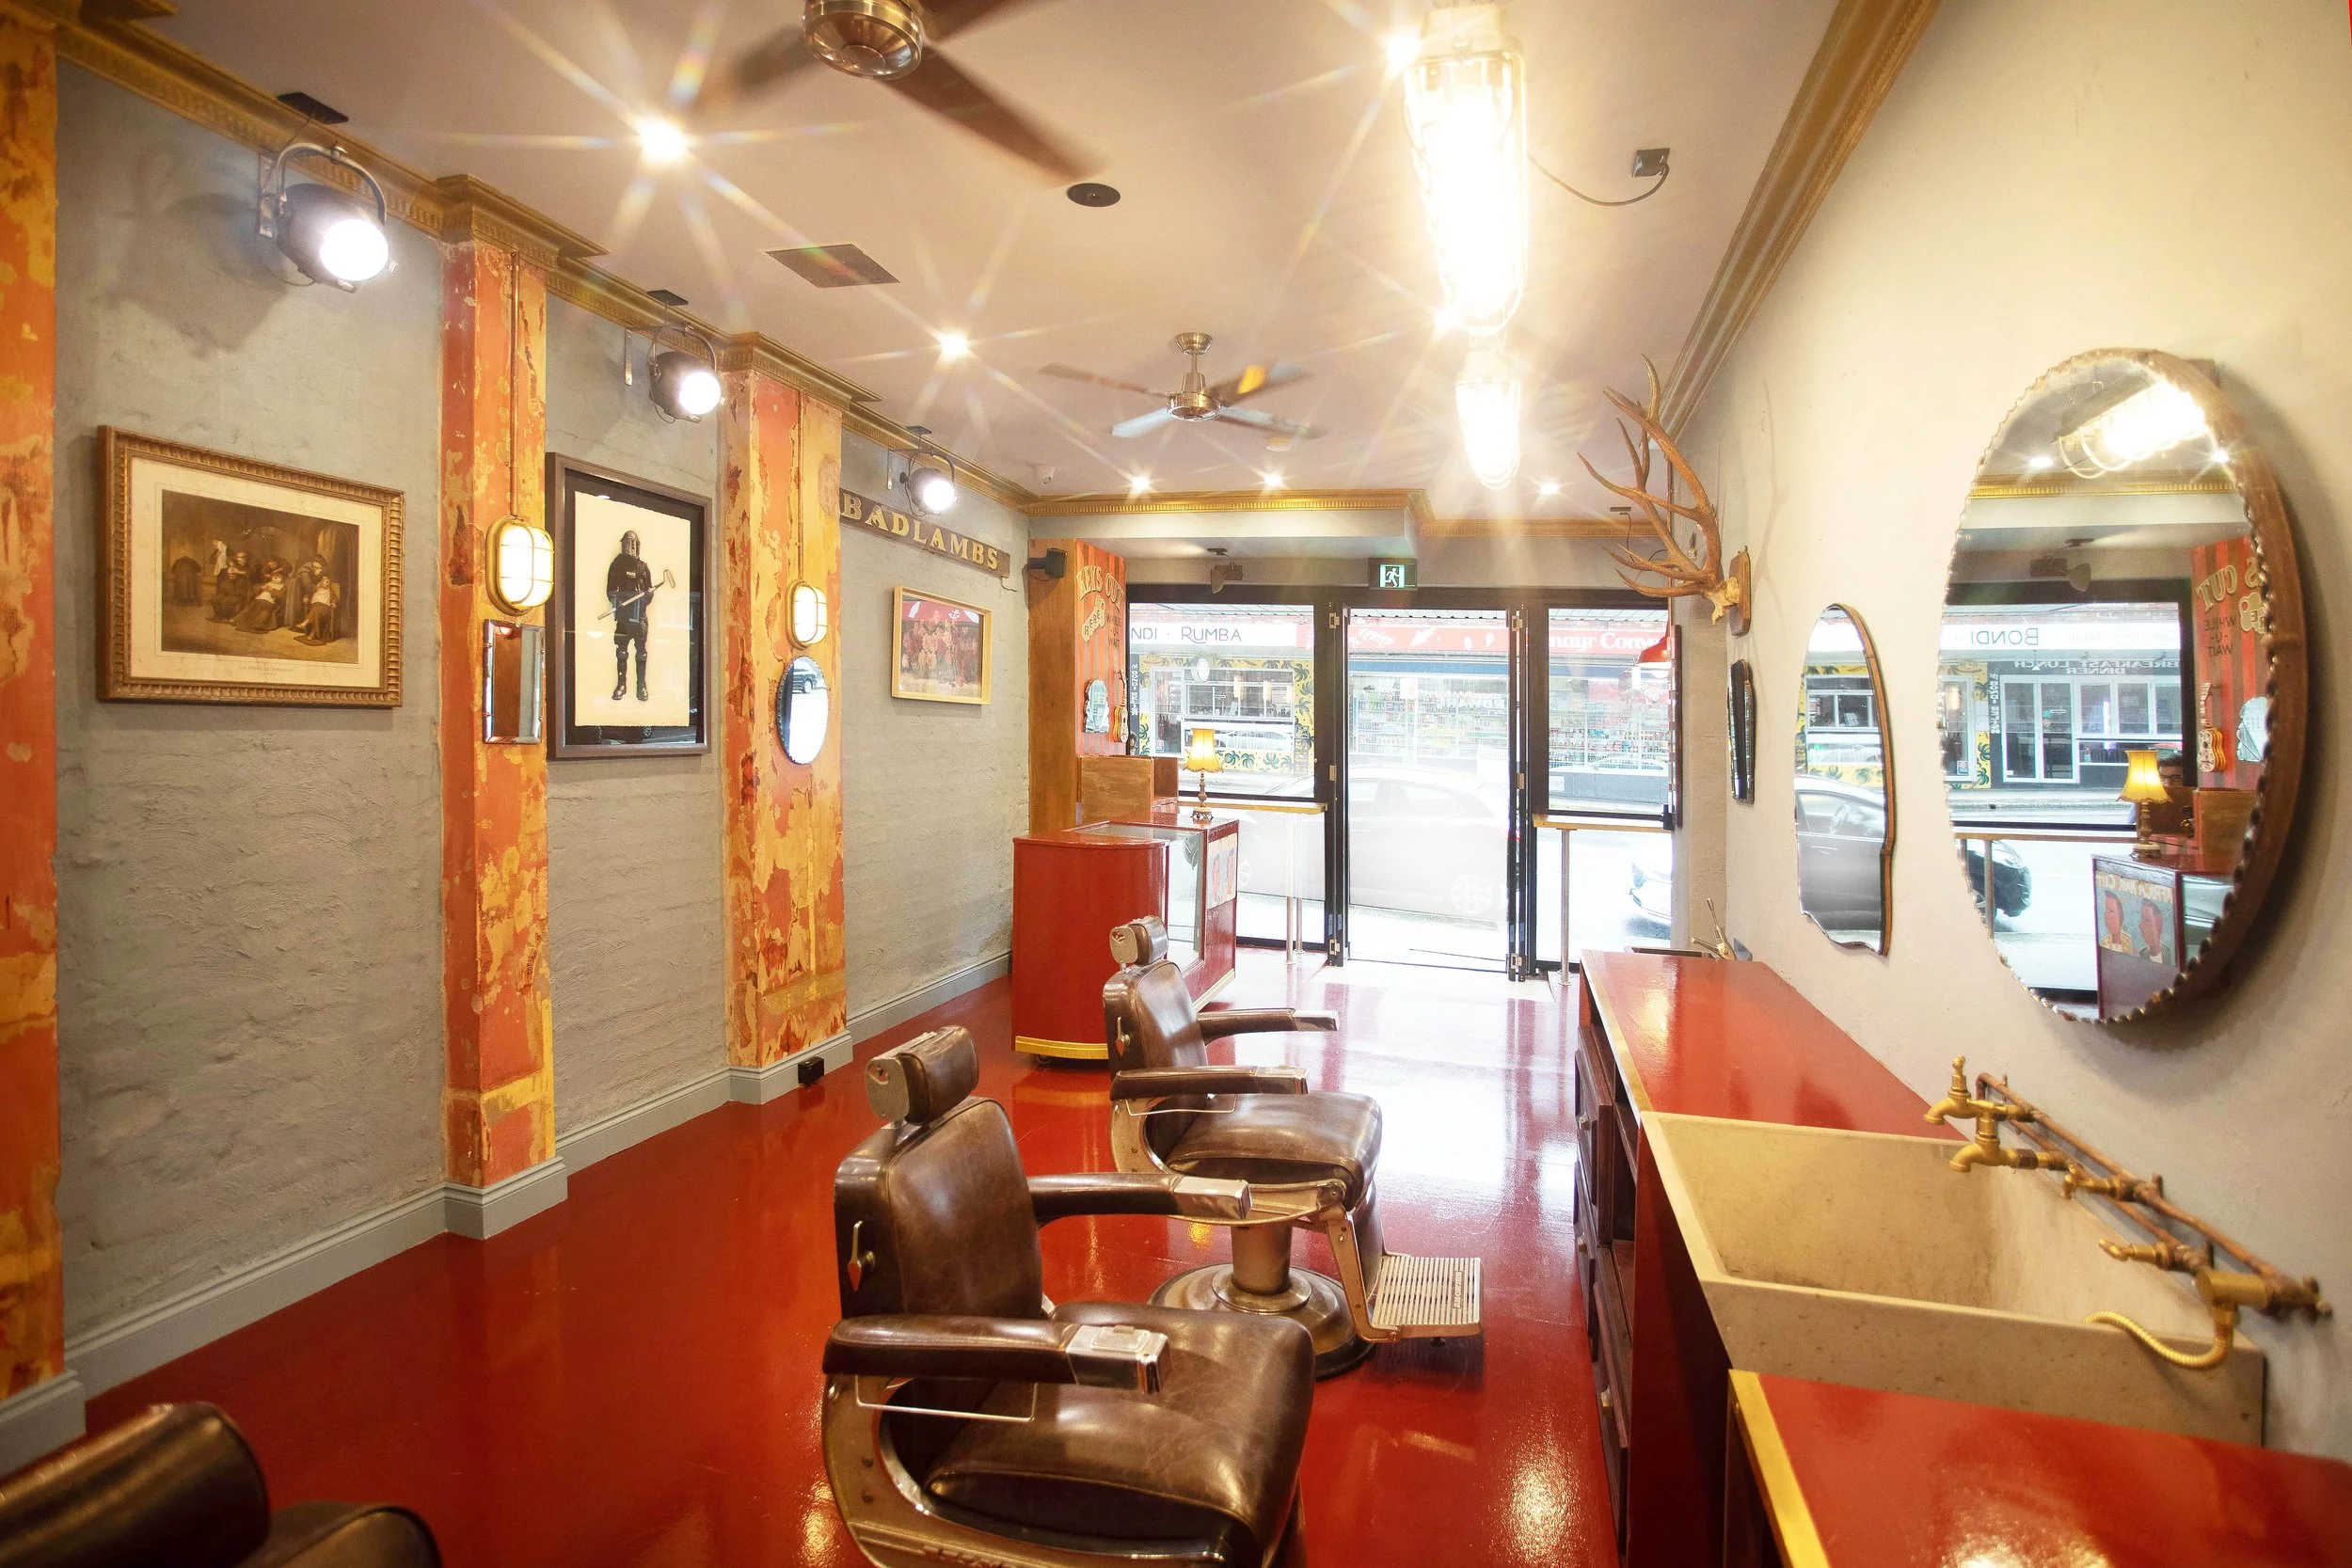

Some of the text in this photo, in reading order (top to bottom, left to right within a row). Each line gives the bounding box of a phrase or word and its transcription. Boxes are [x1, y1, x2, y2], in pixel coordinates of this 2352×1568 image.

[841, 493, 998, 570] BADLAMBS
[1105, 572, 1123, 611] CUT
[1181, 626, 1242, 643] RUMBA
